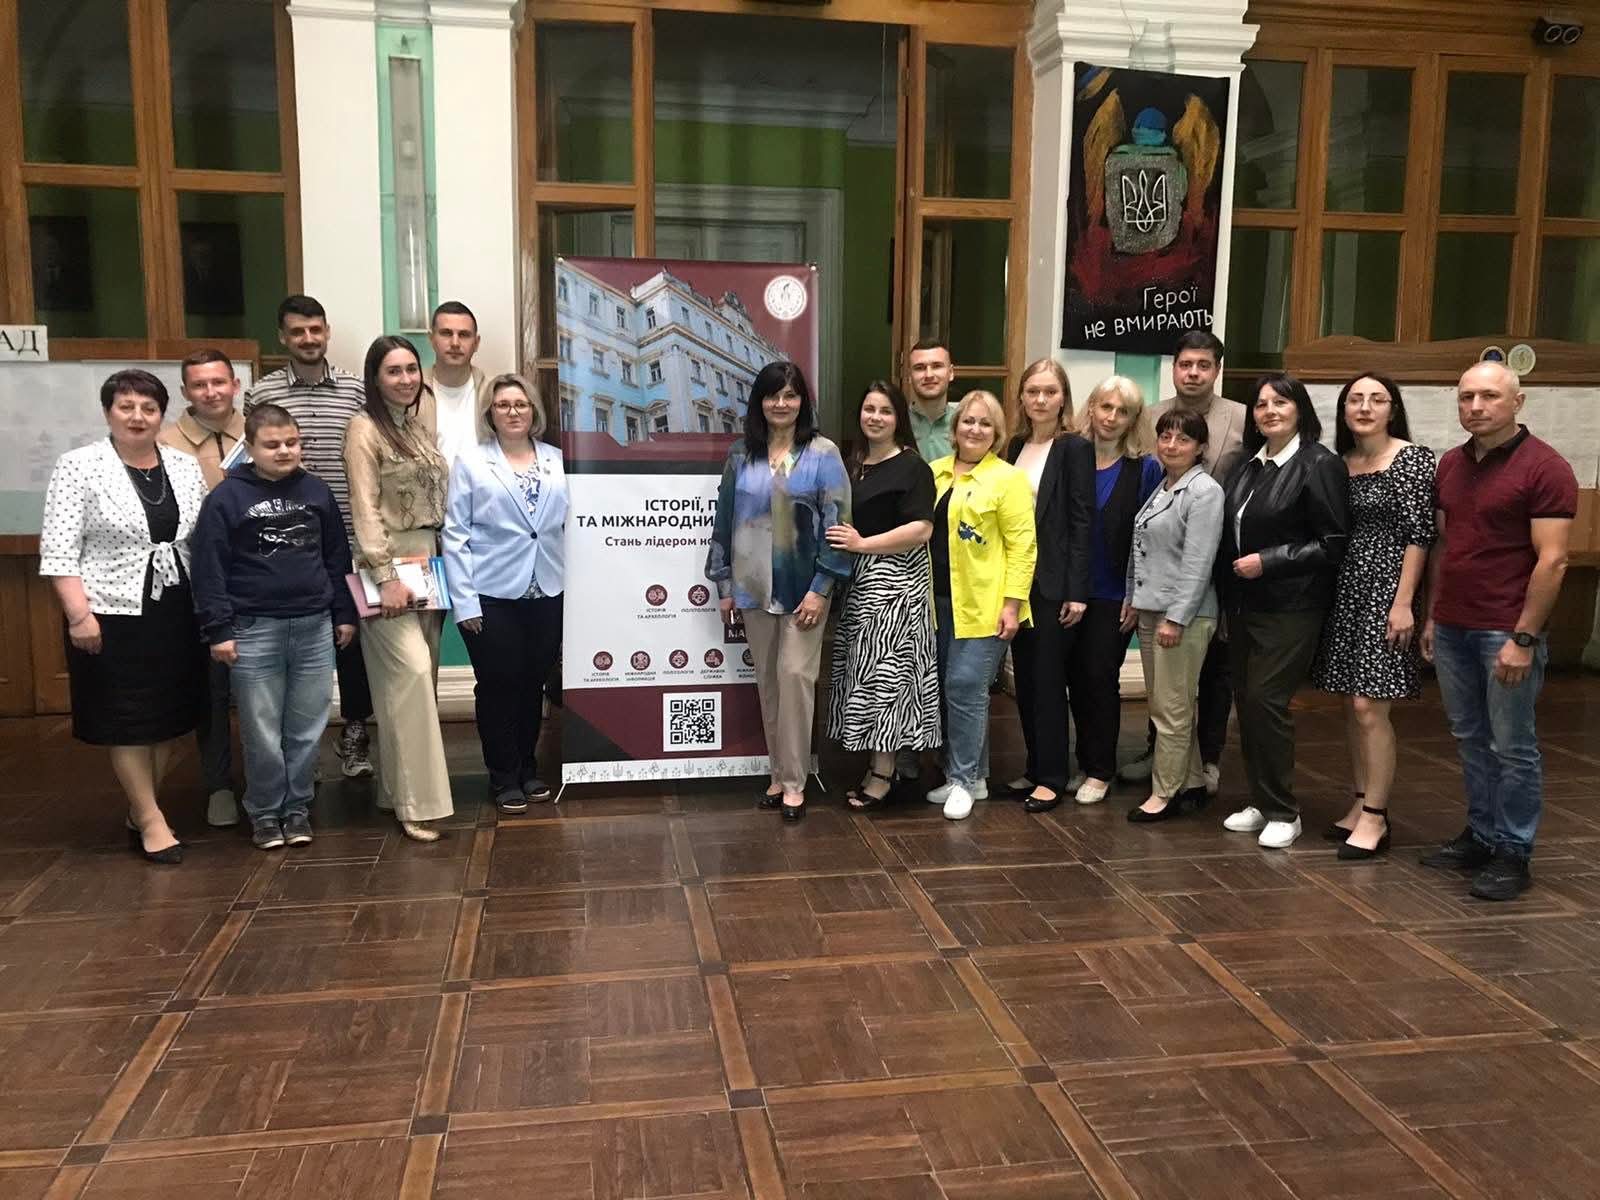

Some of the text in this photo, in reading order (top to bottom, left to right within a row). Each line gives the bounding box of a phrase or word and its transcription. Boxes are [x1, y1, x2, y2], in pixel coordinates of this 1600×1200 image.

[1143, 286, 1199, 313] Герої
[1085, 320, 1106, 339] не
[645, 497, 704, 513] ІСТОРІЇ,
[577, 515, 714, 530] ТА МІЖНАРОДНИ
[605, 536, 642, 546] Стань
[645, 536, 697, 547] лідером
